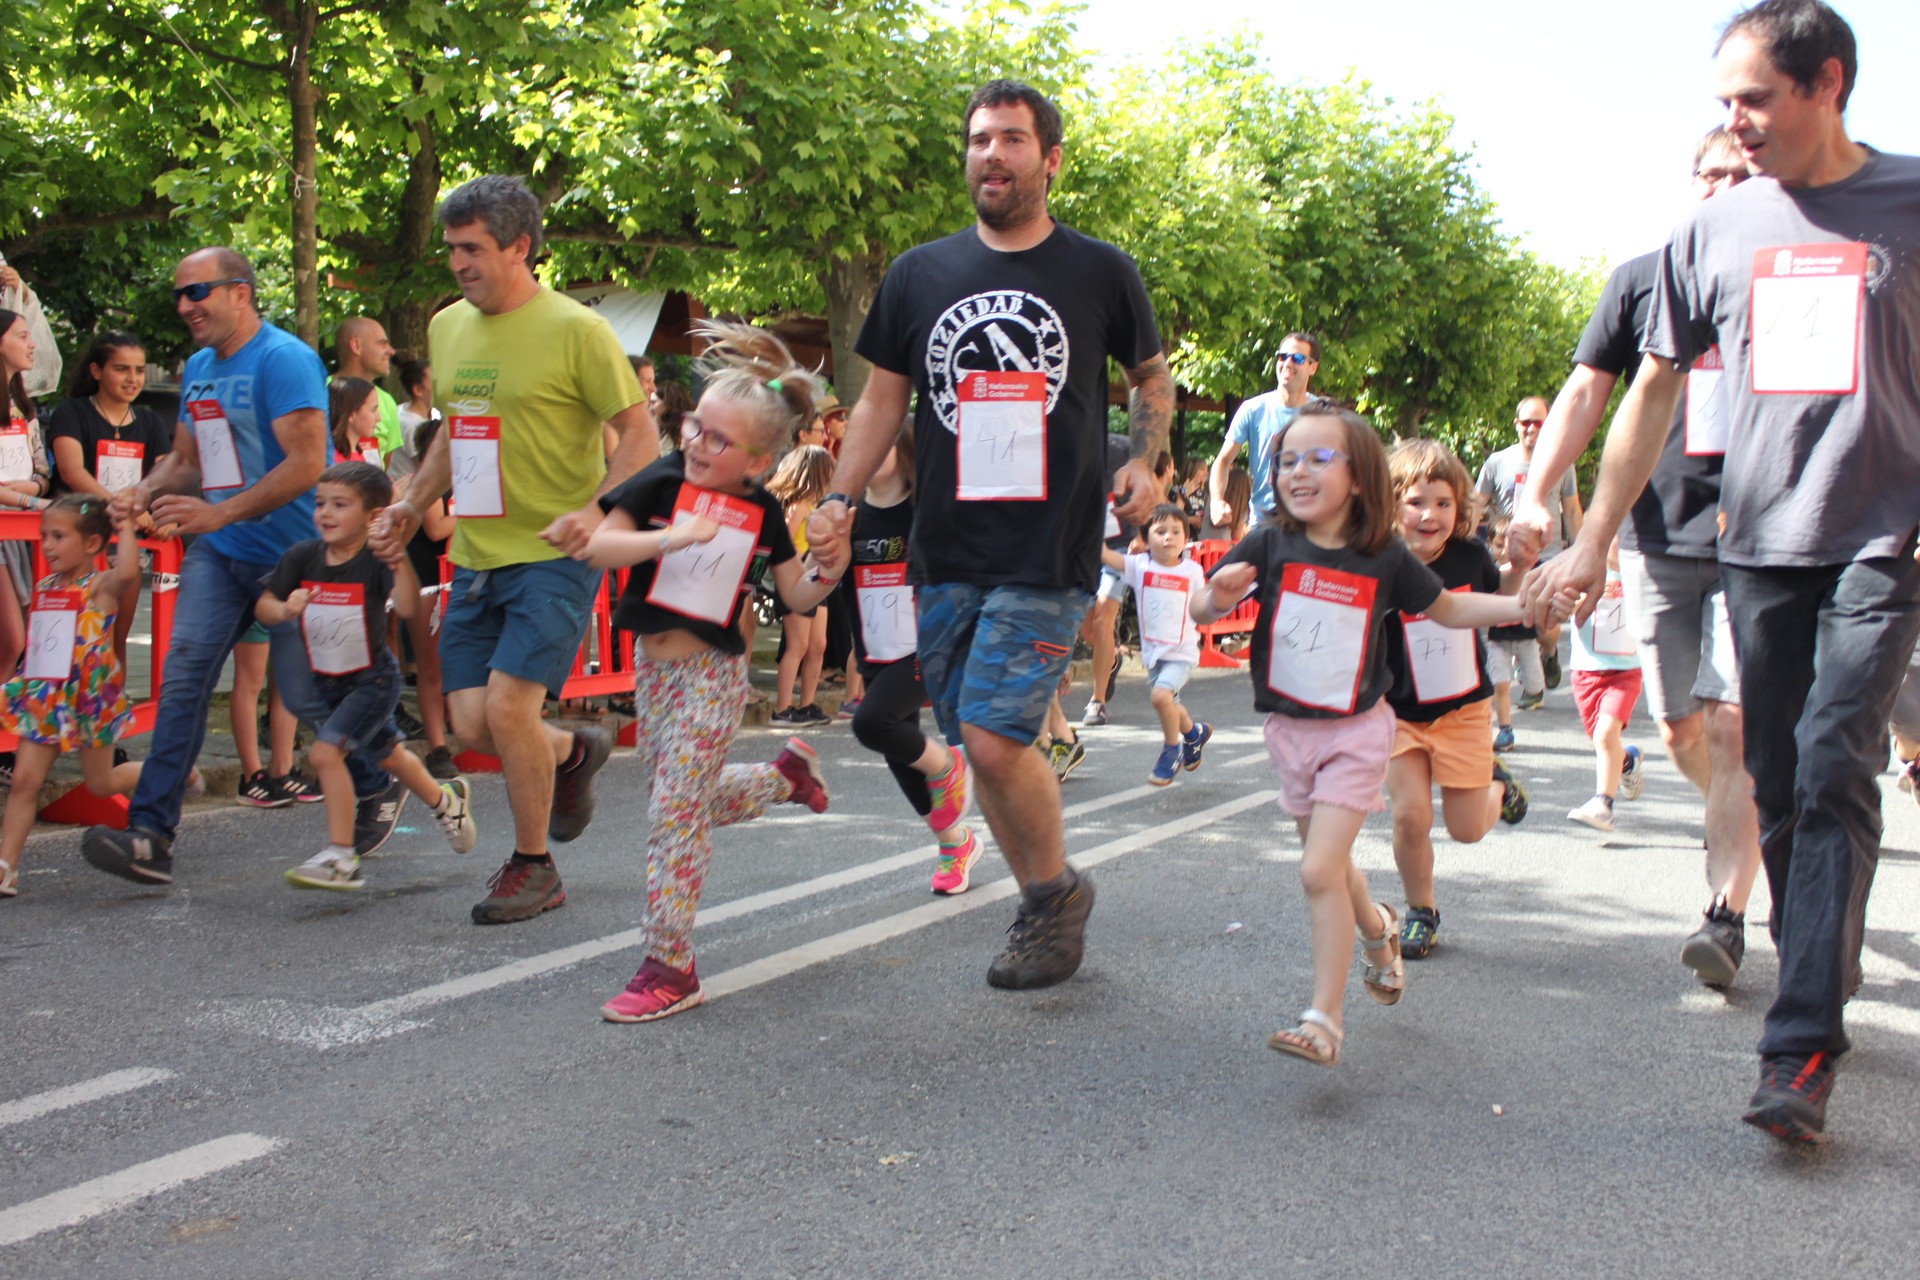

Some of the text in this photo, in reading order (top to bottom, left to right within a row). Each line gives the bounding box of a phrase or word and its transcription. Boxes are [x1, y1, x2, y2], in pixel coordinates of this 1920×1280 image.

[452, 381, 496, 400] NAGO!
[455, 368, 499, 380] HARRO
[977, 422, 1019, 465] 41
[862, 592, 899, 635] 29
[1281, 615, 1325, 653] 21
[1415, 636, 1452, 665] 77
